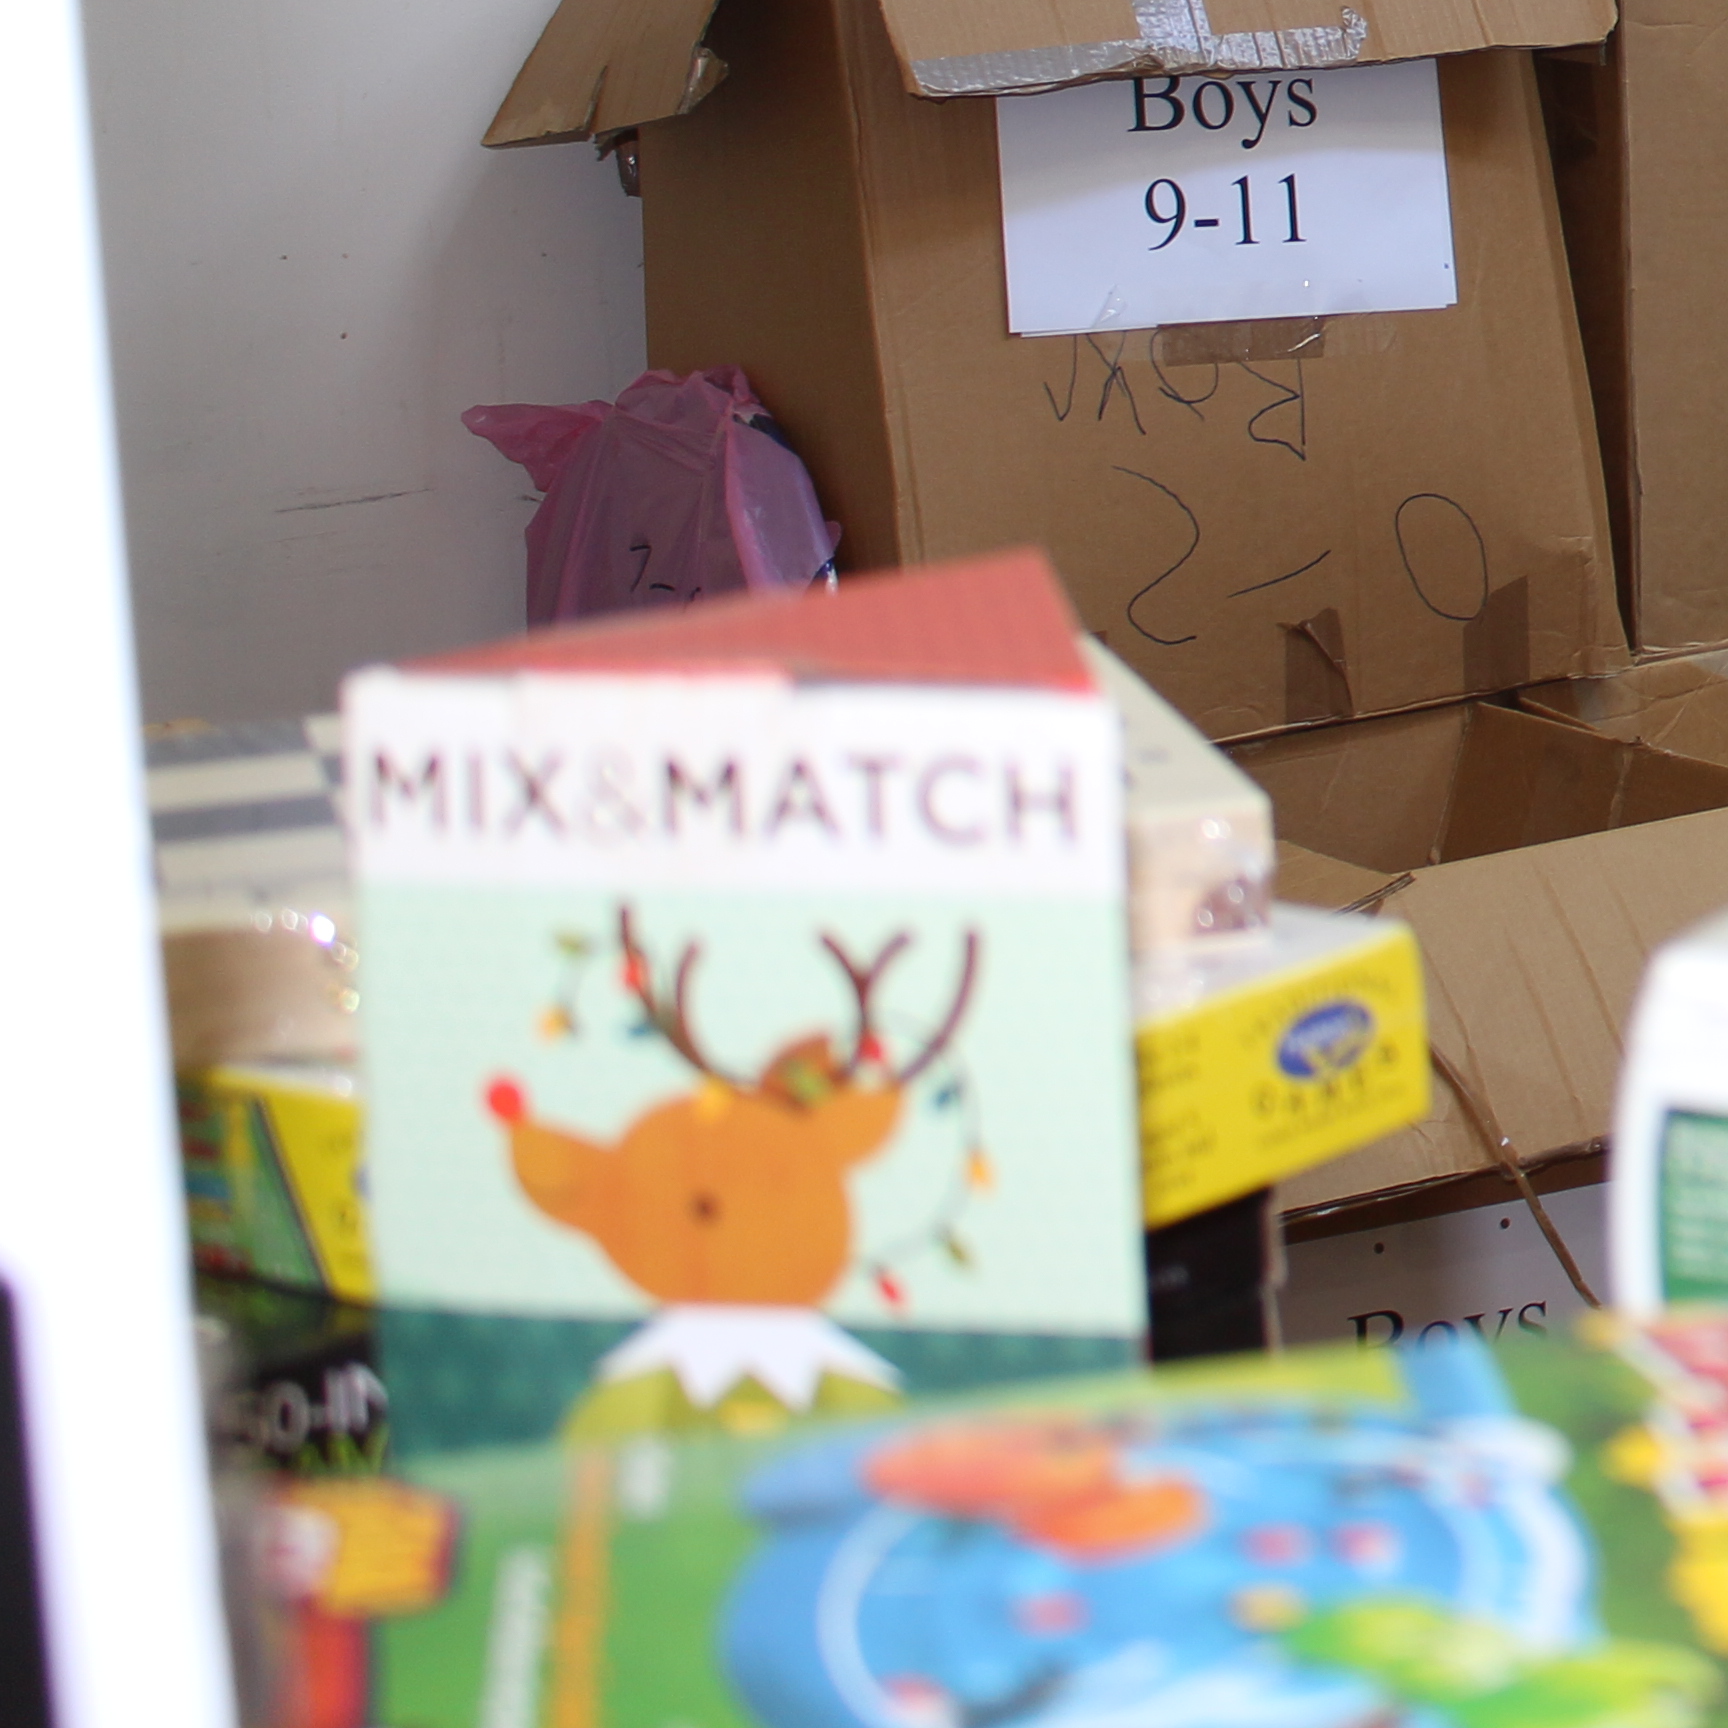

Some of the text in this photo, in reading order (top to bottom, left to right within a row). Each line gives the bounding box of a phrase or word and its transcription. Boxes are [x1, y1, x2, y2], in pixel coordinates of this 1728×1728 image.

[1127, 73, 1319, 149] Boys
[1143, 173, 1309, 252] 9-11
[366, 744, 1082, 849] MIX&MATCH
